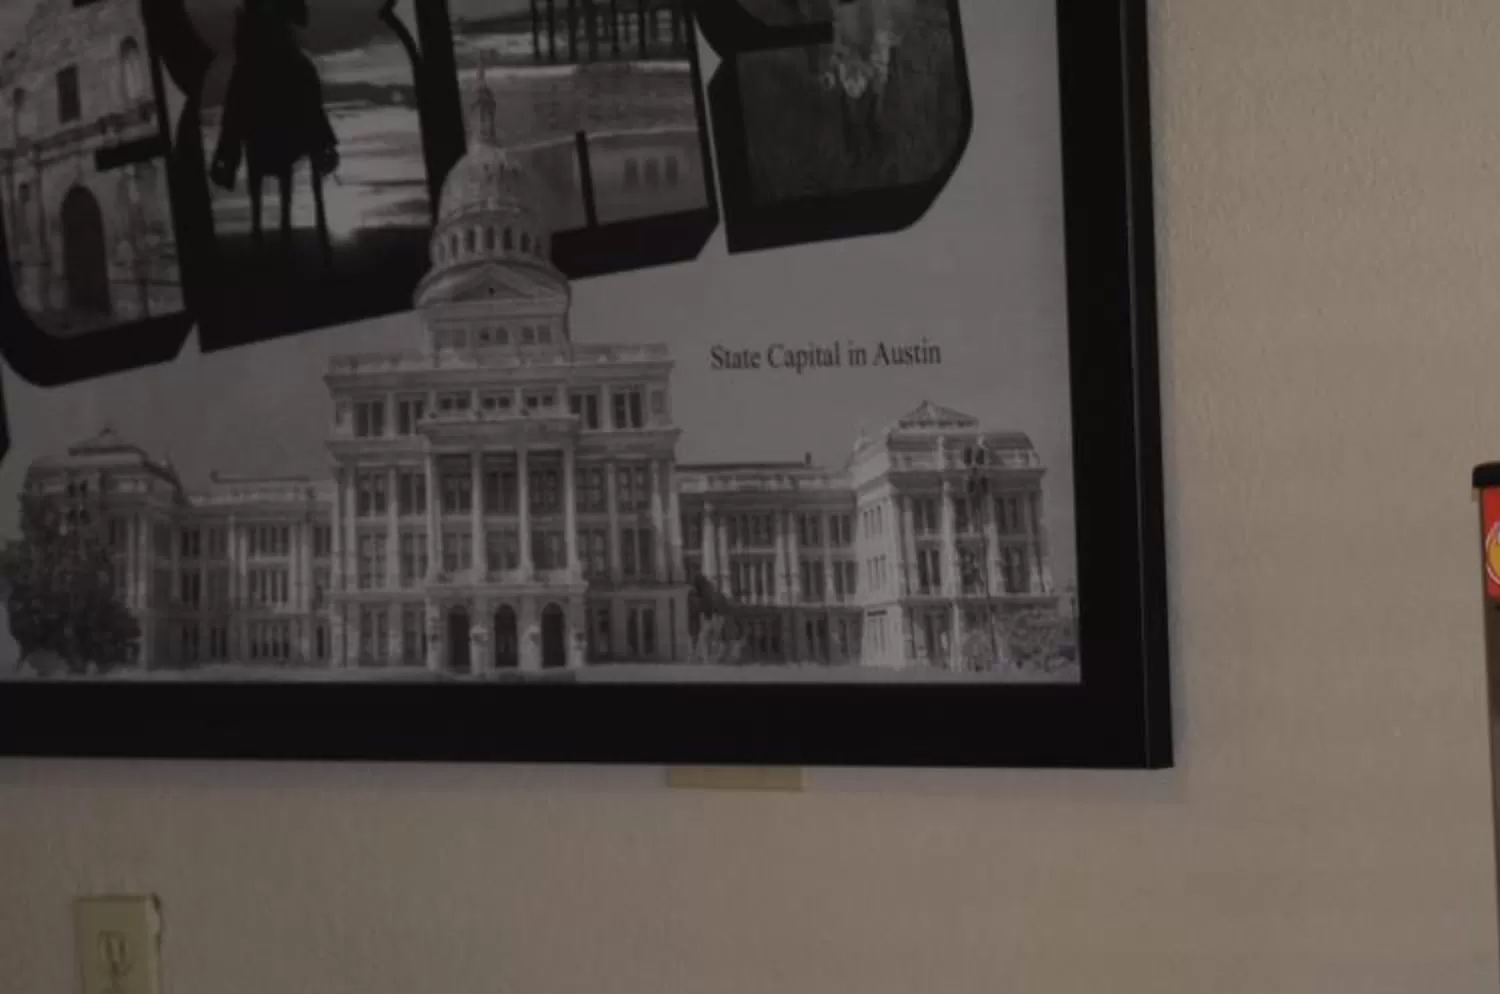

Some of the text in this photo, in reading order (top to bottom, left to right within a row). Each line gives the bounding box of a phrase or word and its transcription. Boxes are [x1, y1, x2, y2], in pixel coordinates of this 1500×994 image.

[710, 336, 942, 375] State Capital in Austin
